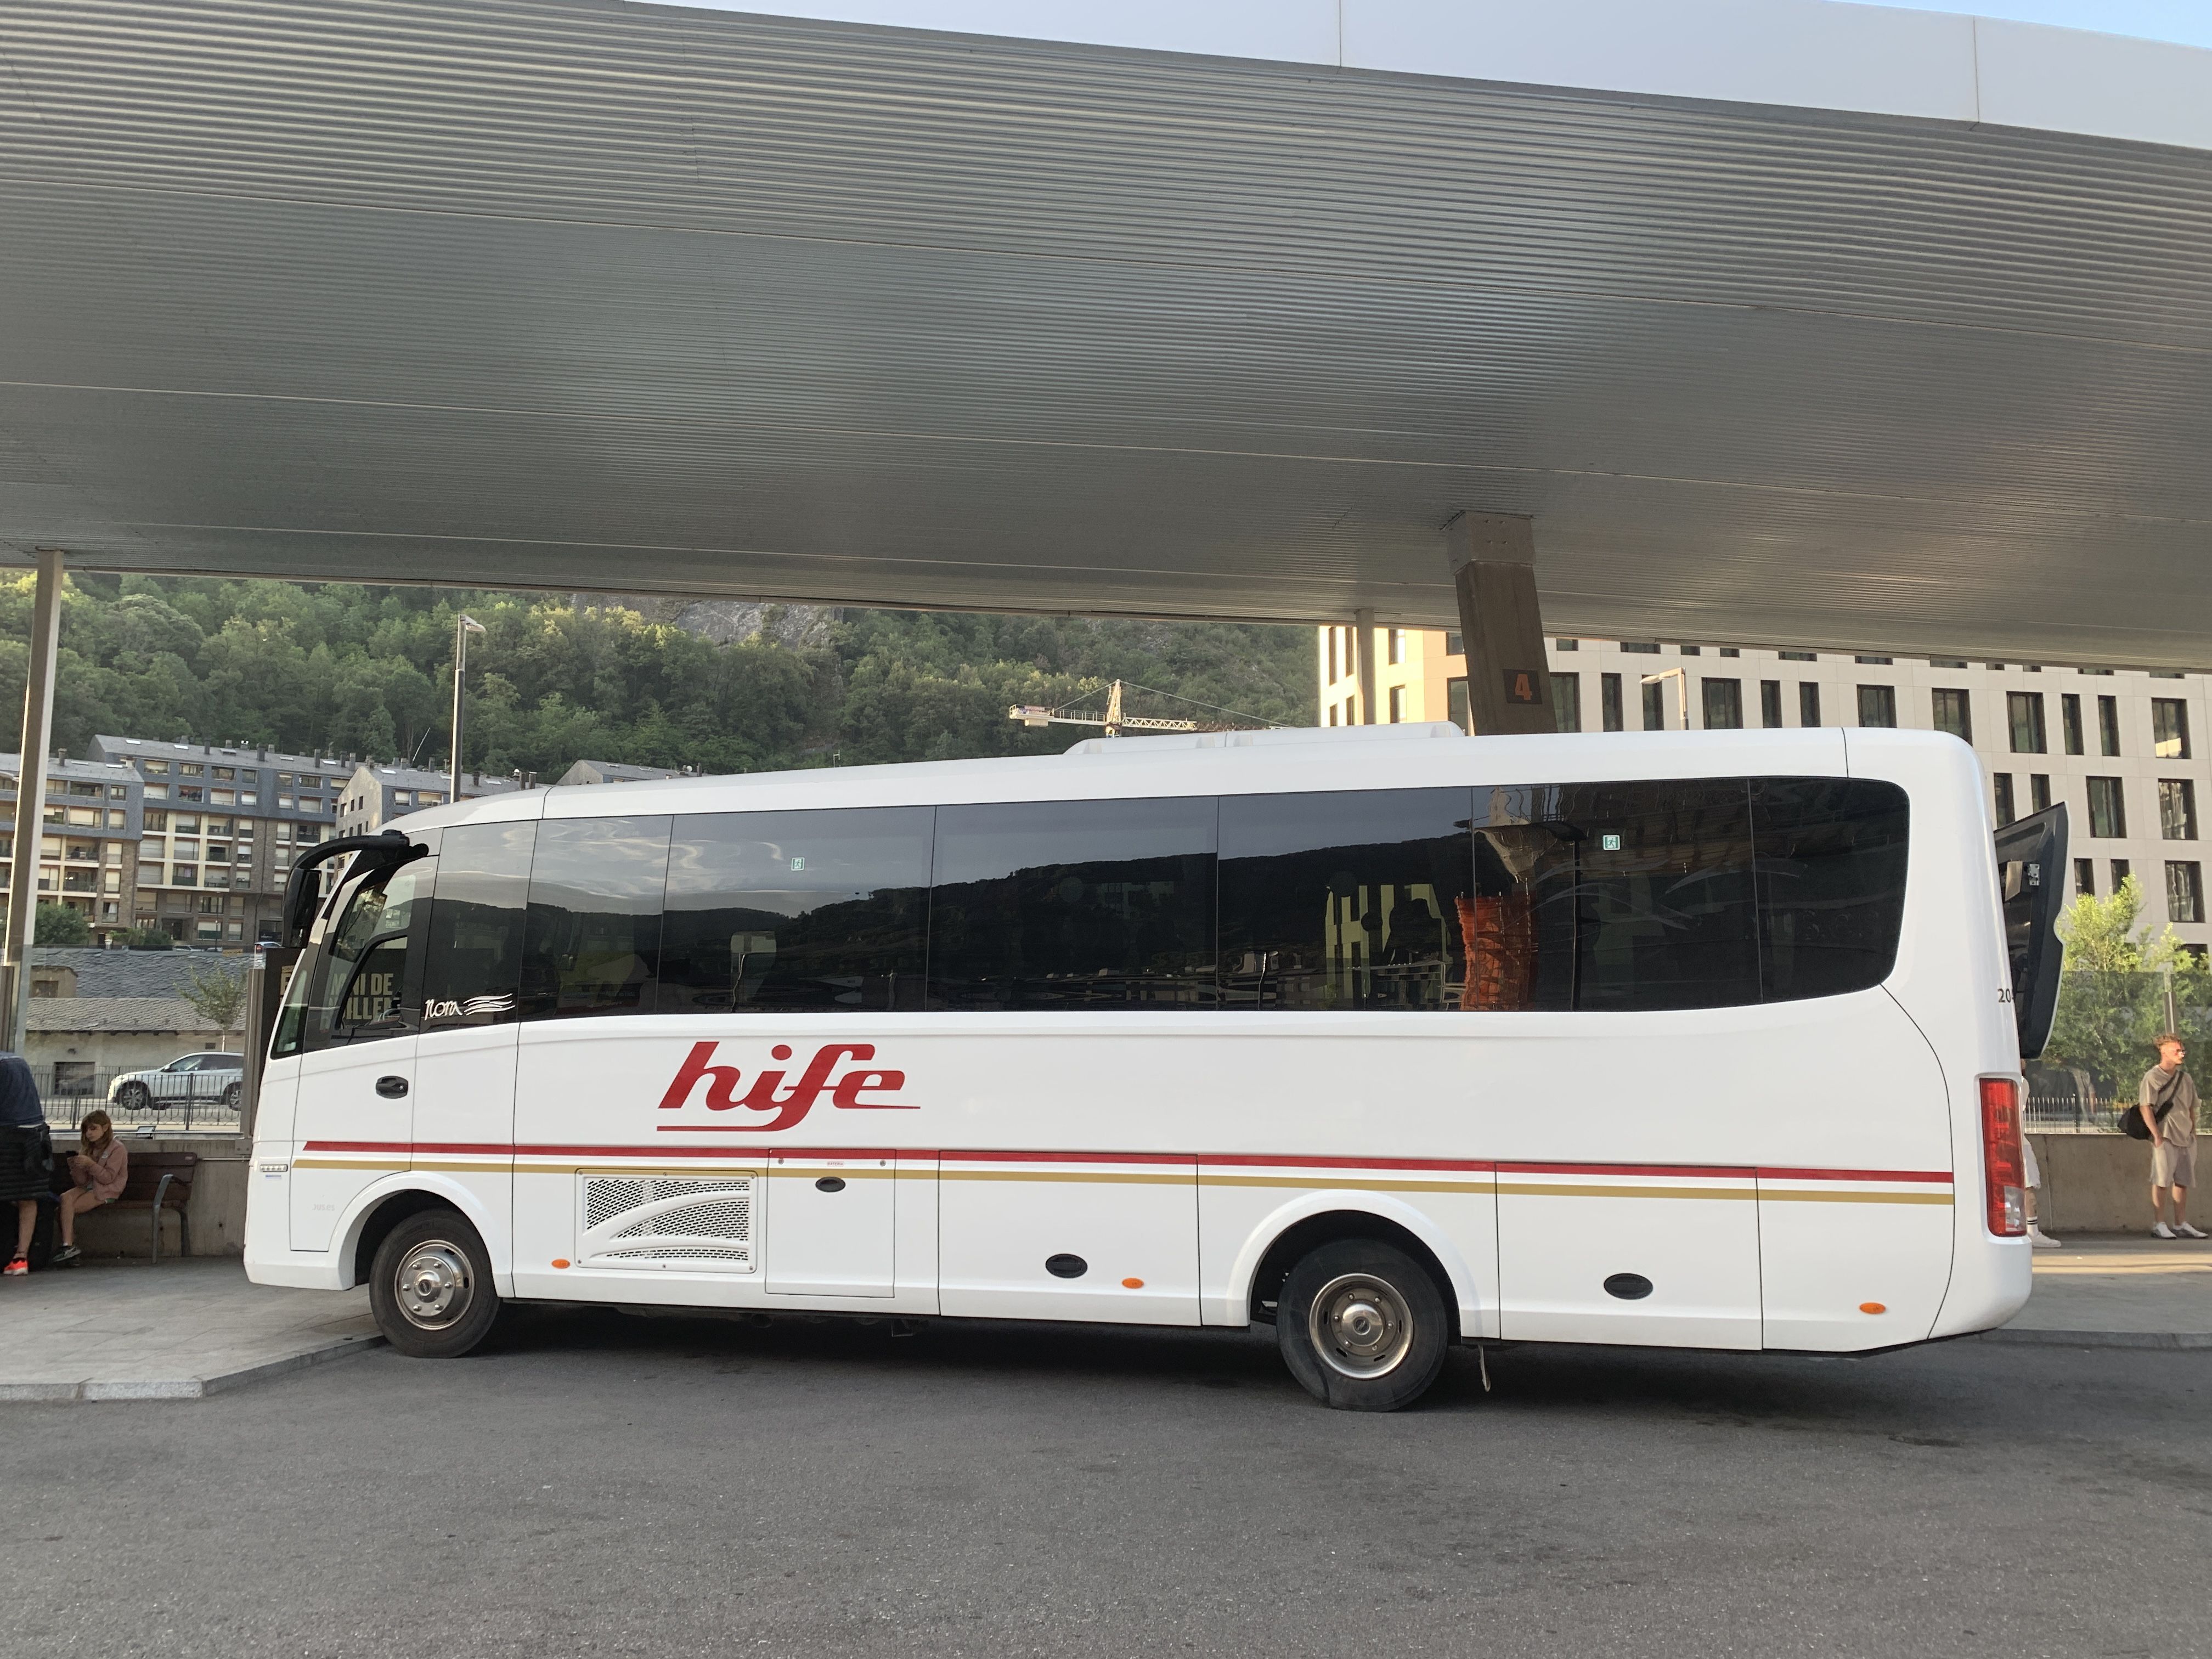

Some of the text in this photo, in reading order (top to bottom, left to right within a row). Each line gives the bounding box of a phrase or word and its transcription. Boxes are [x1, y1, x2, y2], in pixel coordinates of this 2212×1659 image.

[1515, 674, 1532, 700] 4
[370, 973, 393, 995] DE
[657, 1041, 921, 1131] hife
